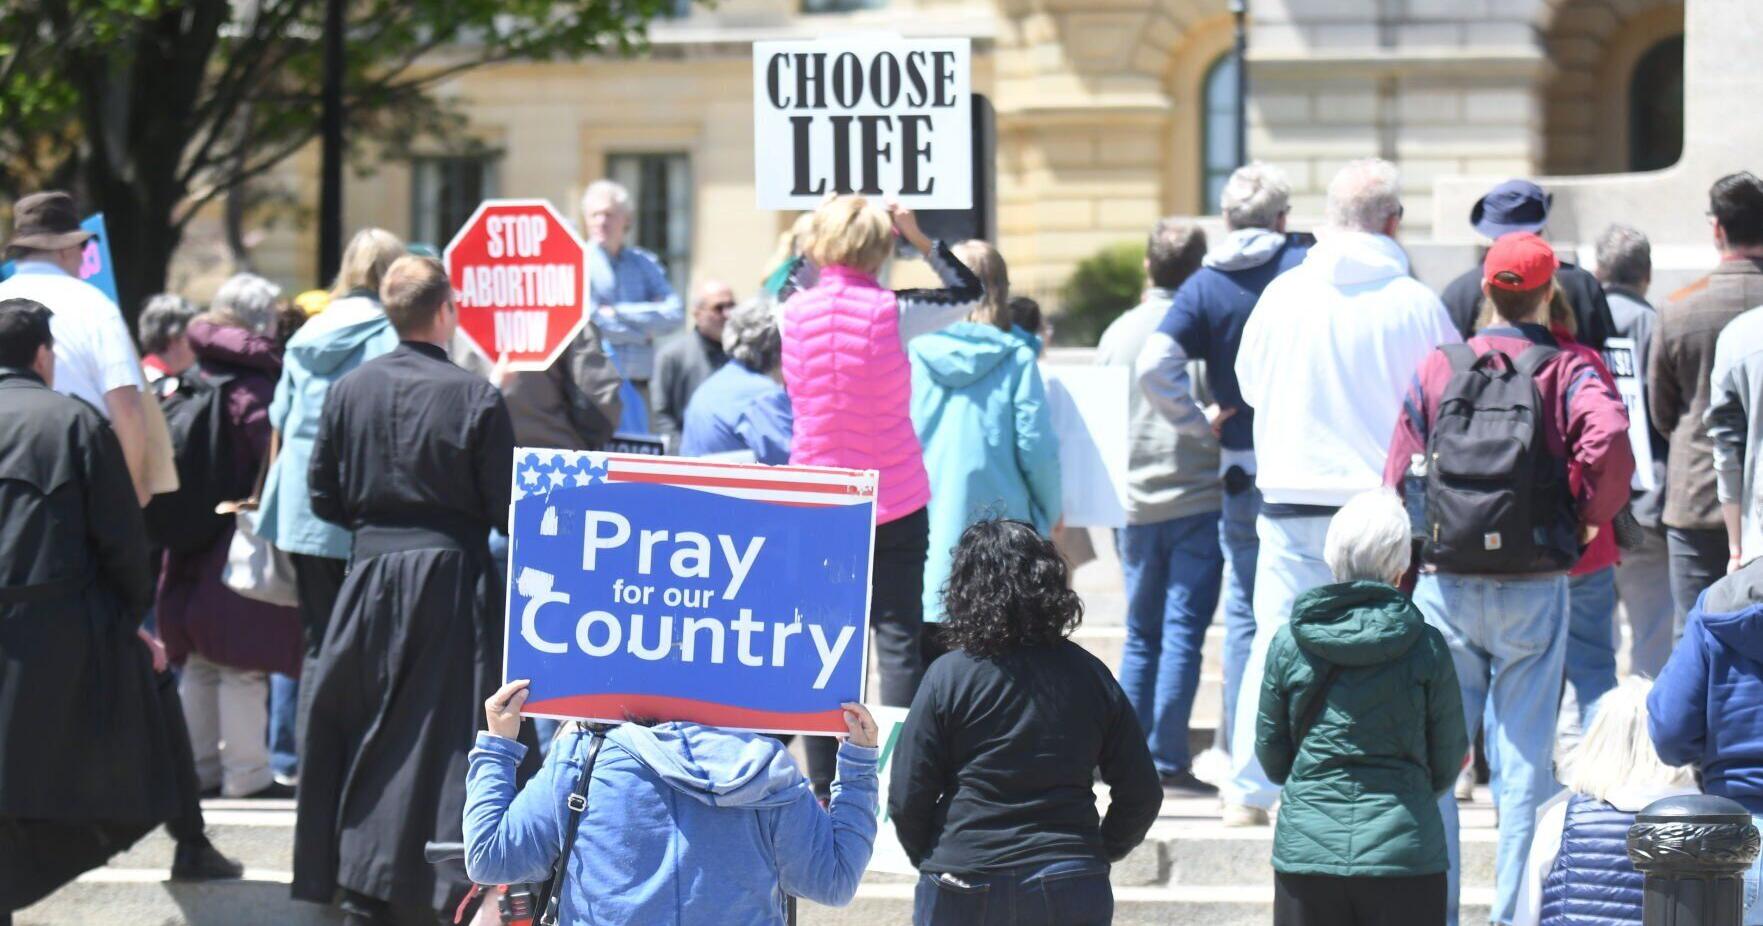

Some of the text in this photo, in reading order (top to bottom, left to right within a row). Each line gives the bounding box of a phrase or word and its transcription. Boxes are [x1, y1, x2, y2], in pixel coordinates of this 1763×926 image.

[767, 51, 957, 109] CHOOSE
[789, 115, 935, 195] LIFE
[486, 214, 548, 258] STOP
[461, 263, 576, 307] ABORTION
[494, 310, 549, 353] NOW
[582, 510, 767, 600] Pray
[613, 579, 714, 609] for our
[521, 591, 857, 690] Country
